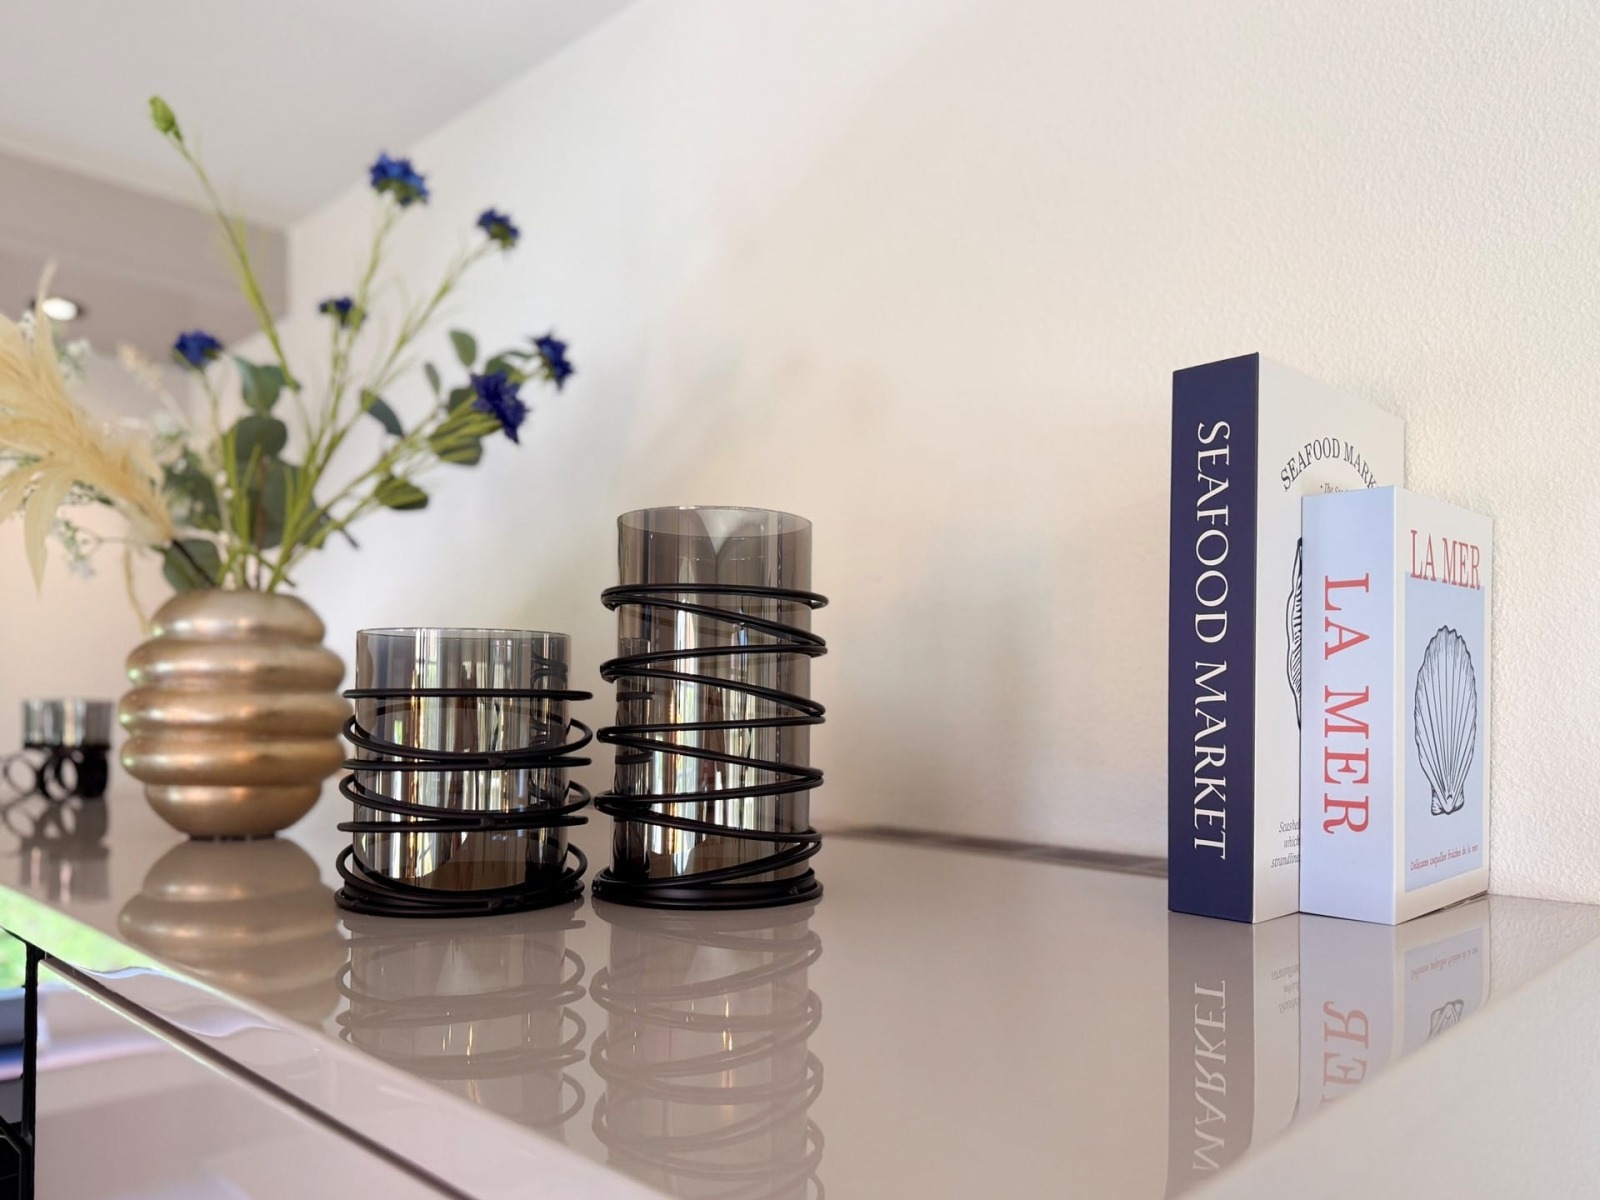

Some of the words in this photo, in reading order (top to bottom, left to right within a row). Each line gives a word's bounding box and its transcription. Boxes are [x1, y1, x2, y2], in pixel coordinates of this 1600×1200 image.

[1280, 437, 1341, 491] SEAFOOD
[1342, 441, 1379, 489] MARK
[1195, 420, 1231, 643] SEAFOOD
[1409, 529, 1437, 582] LA
[1442, 537, 1481, 591] MER
[1324, 572, 1371, 660] LA
[1194, 660, 1228, 860] MARKET
[1322, 685, 1370, 834] MER
